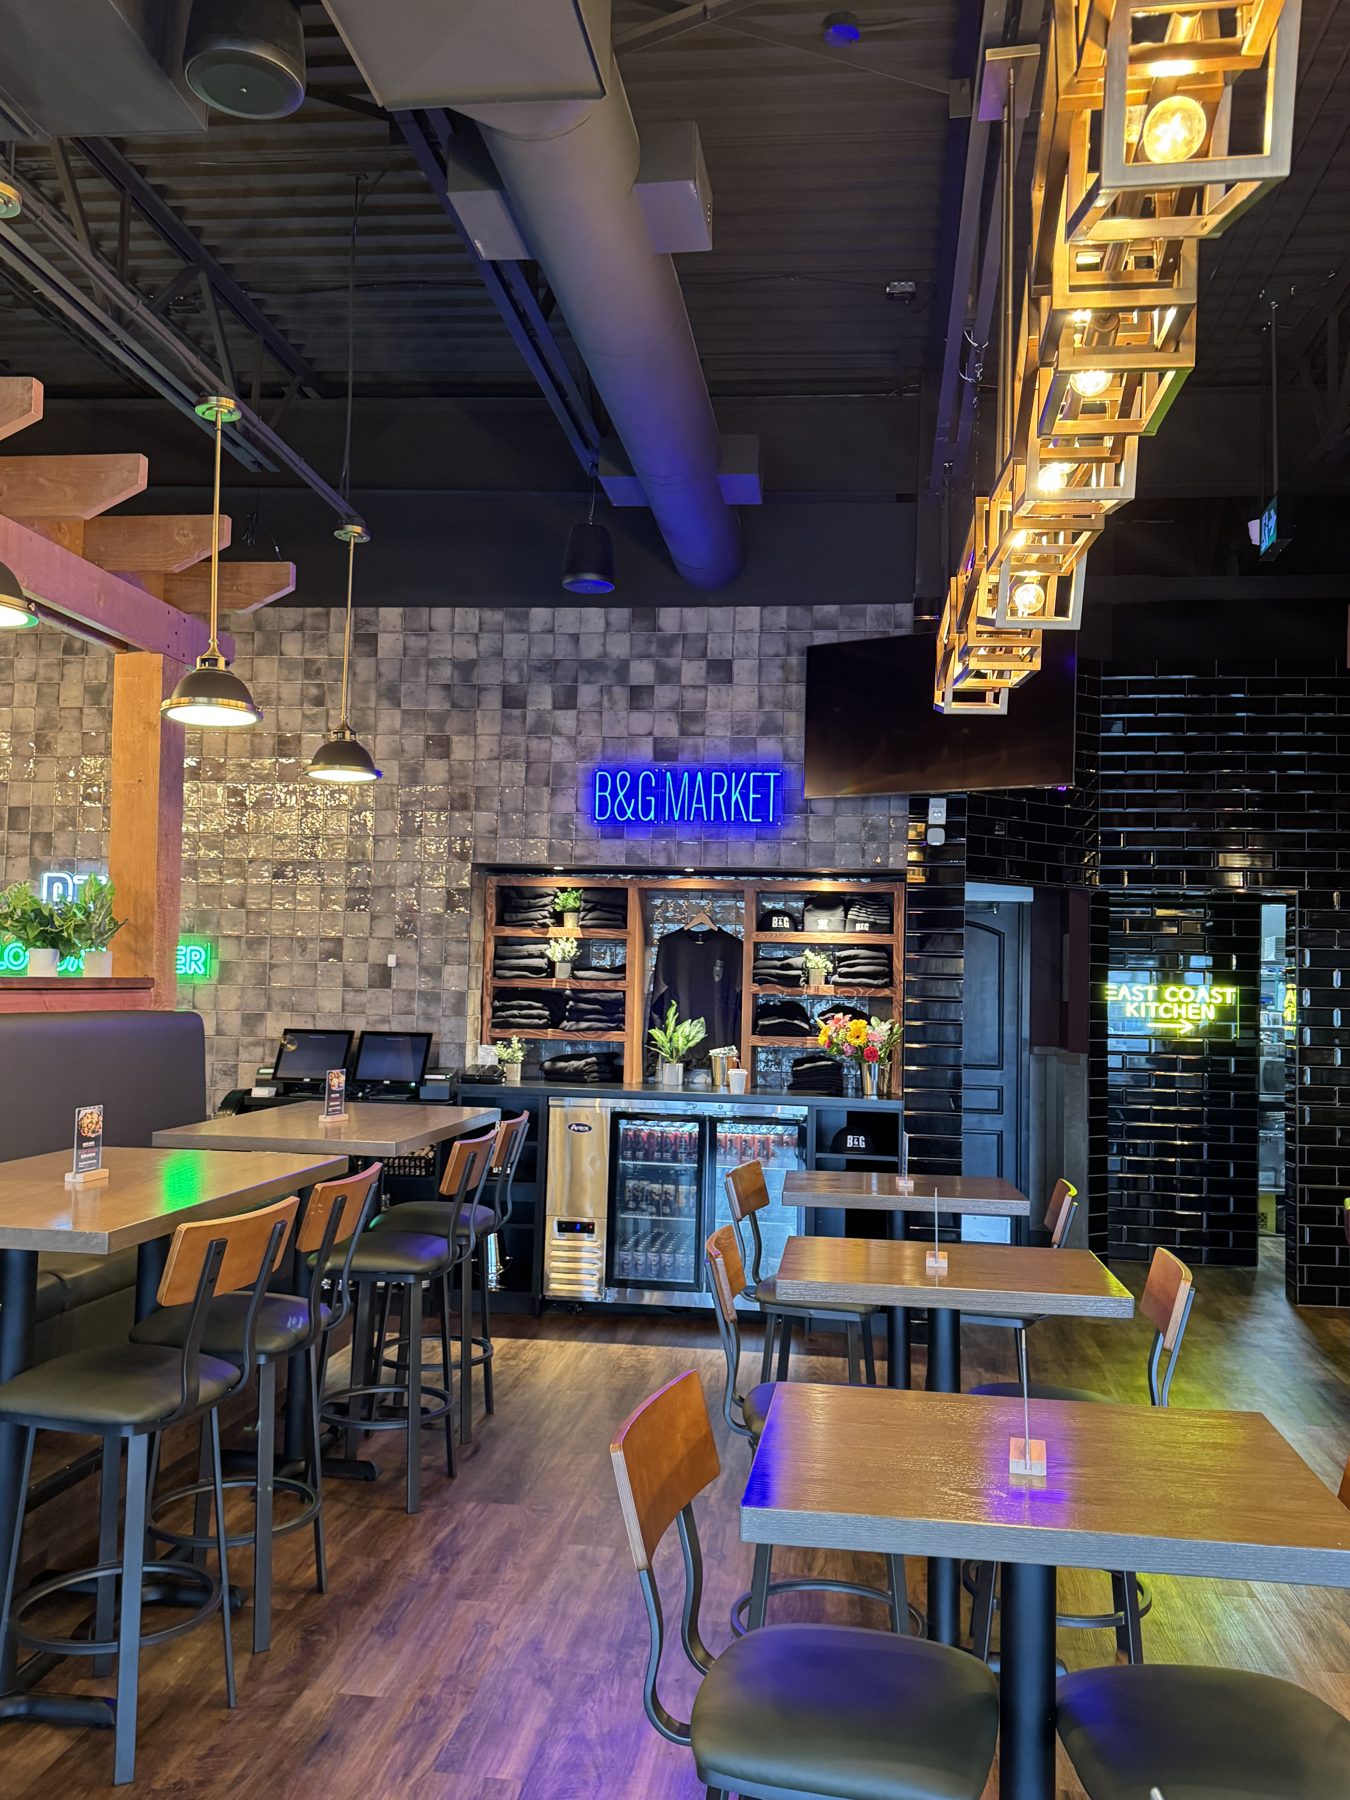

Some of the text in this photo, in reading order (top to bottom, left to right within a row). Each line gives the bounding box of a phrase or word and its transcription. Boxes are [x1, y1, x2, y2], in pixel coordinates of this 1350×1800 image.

[594, 770, 782, 823] B&G MARKET
[771, 916, 790, 929] B&G
[1105, 984, 1237, 1004] EAST COAST
[1125, 1001, 1216, 1020] KITCHEN
[846, 1134, 866, 1148] B&G
